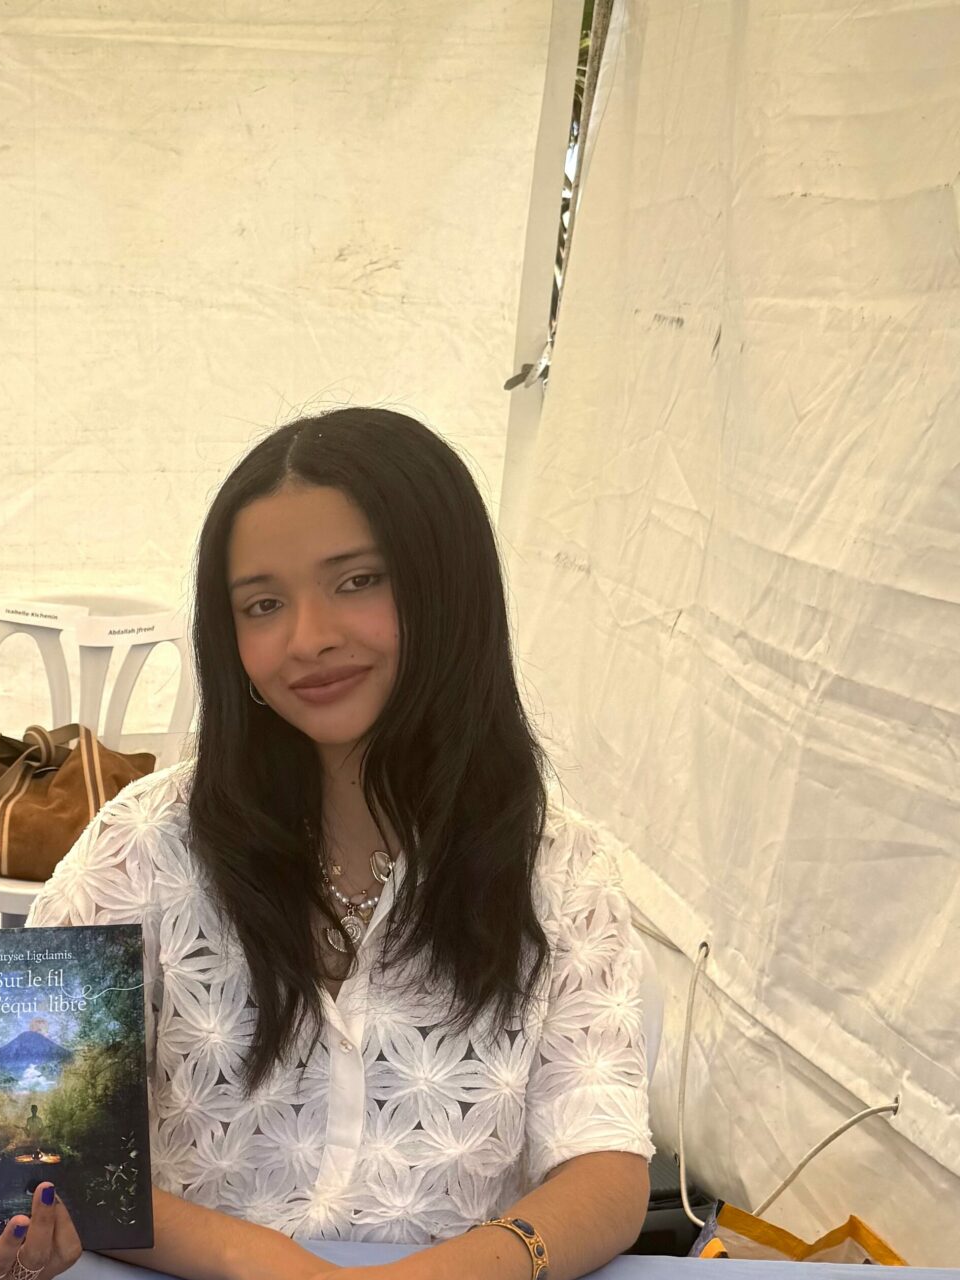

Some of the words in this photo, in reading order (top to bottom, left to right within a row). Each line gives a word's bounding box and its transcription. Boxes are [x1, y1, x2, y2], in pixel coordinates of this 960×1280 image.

[27, 949, 73, 963] Ligdamis
[28, 970, 42, 987] le
[47, 968, 64, 987] fil
